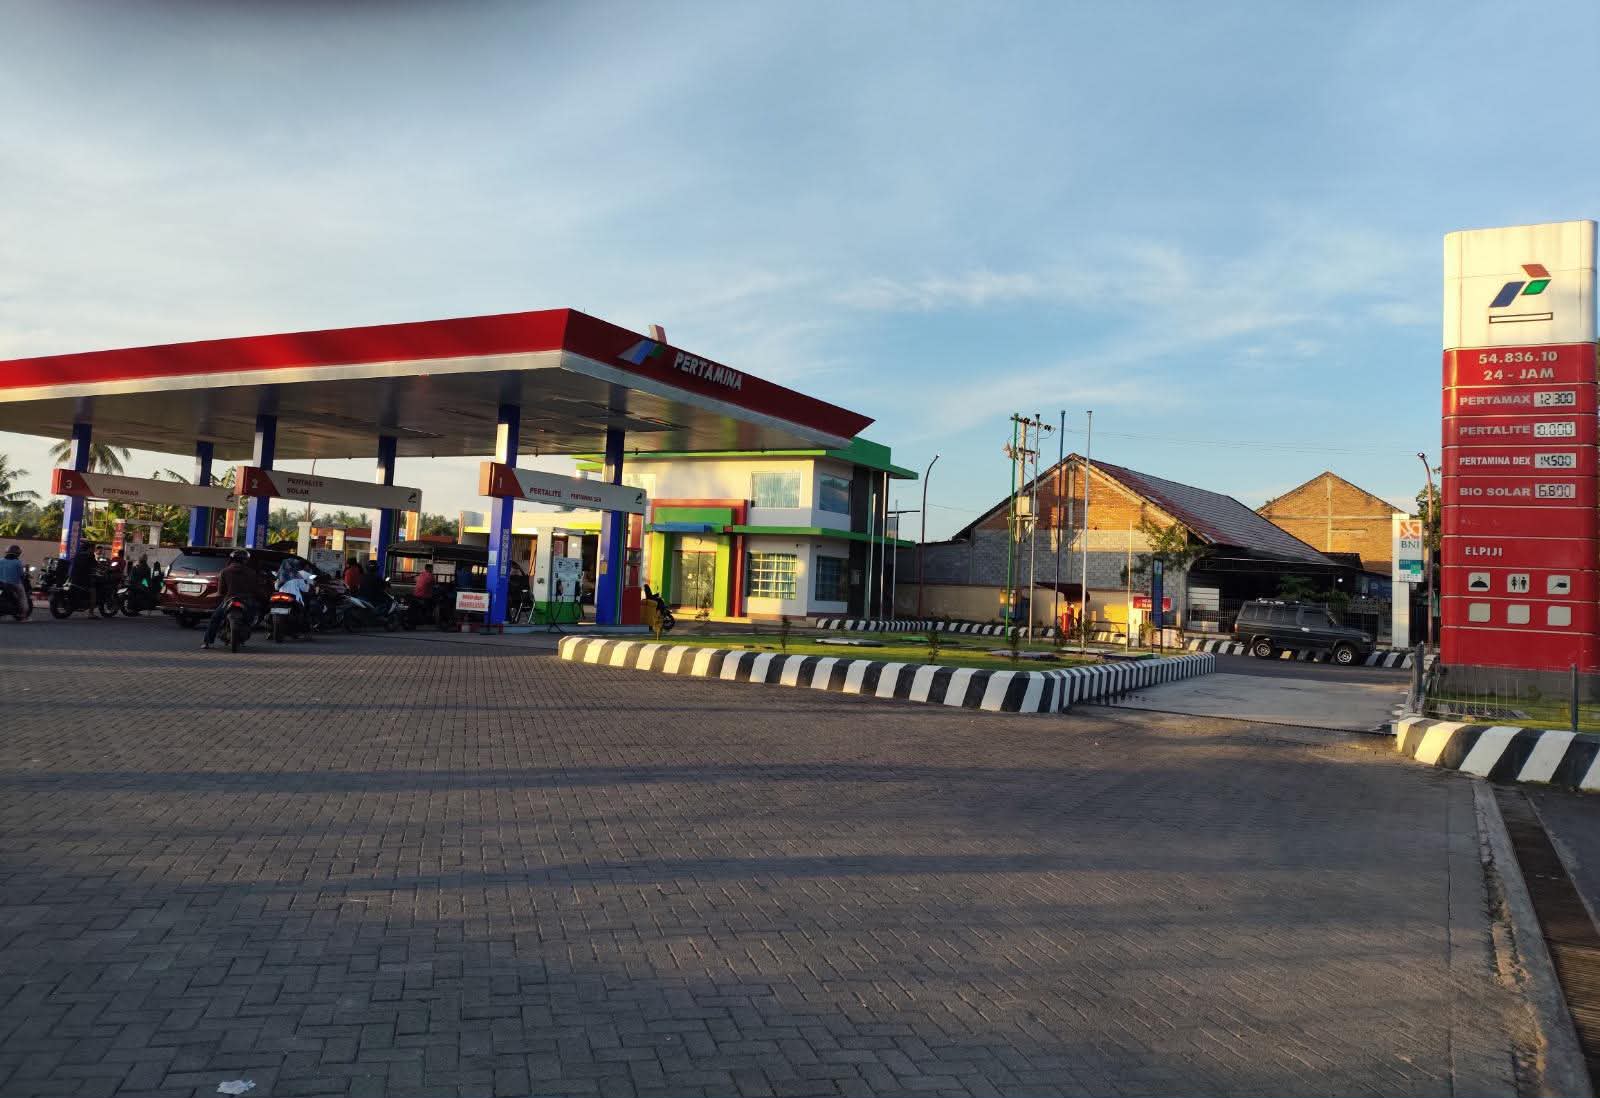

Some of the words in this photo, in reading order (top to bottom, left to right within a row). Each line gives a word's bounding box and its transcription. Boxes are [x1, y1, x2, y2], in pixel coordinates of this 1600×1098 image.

[1479, 351, 1558, 364] 54.836.10
[673, 351, 743, 391] PERTAMINA
[1483, 369, 1504, 381] 24
[1519, 367, 1555, 380] JAM
[1459, 394, 1531, 406] PERTAMAX
[1459, 425, 1531, 436] PERTALITE
[1459, 456, 1511, 466] PERTAMINA
[1512, 456, 1531, 465] DEX
[65, 479, 73, 489] 3
[529, 487, 562, 497] PERTALITE
[1459, 487, 1483, 496] BIO
[1486, 487, 1531, 497] SOLAR
[1401, 540, 1420, 549] BNI
[1465, 546, 1503, 557] ELPIJI
